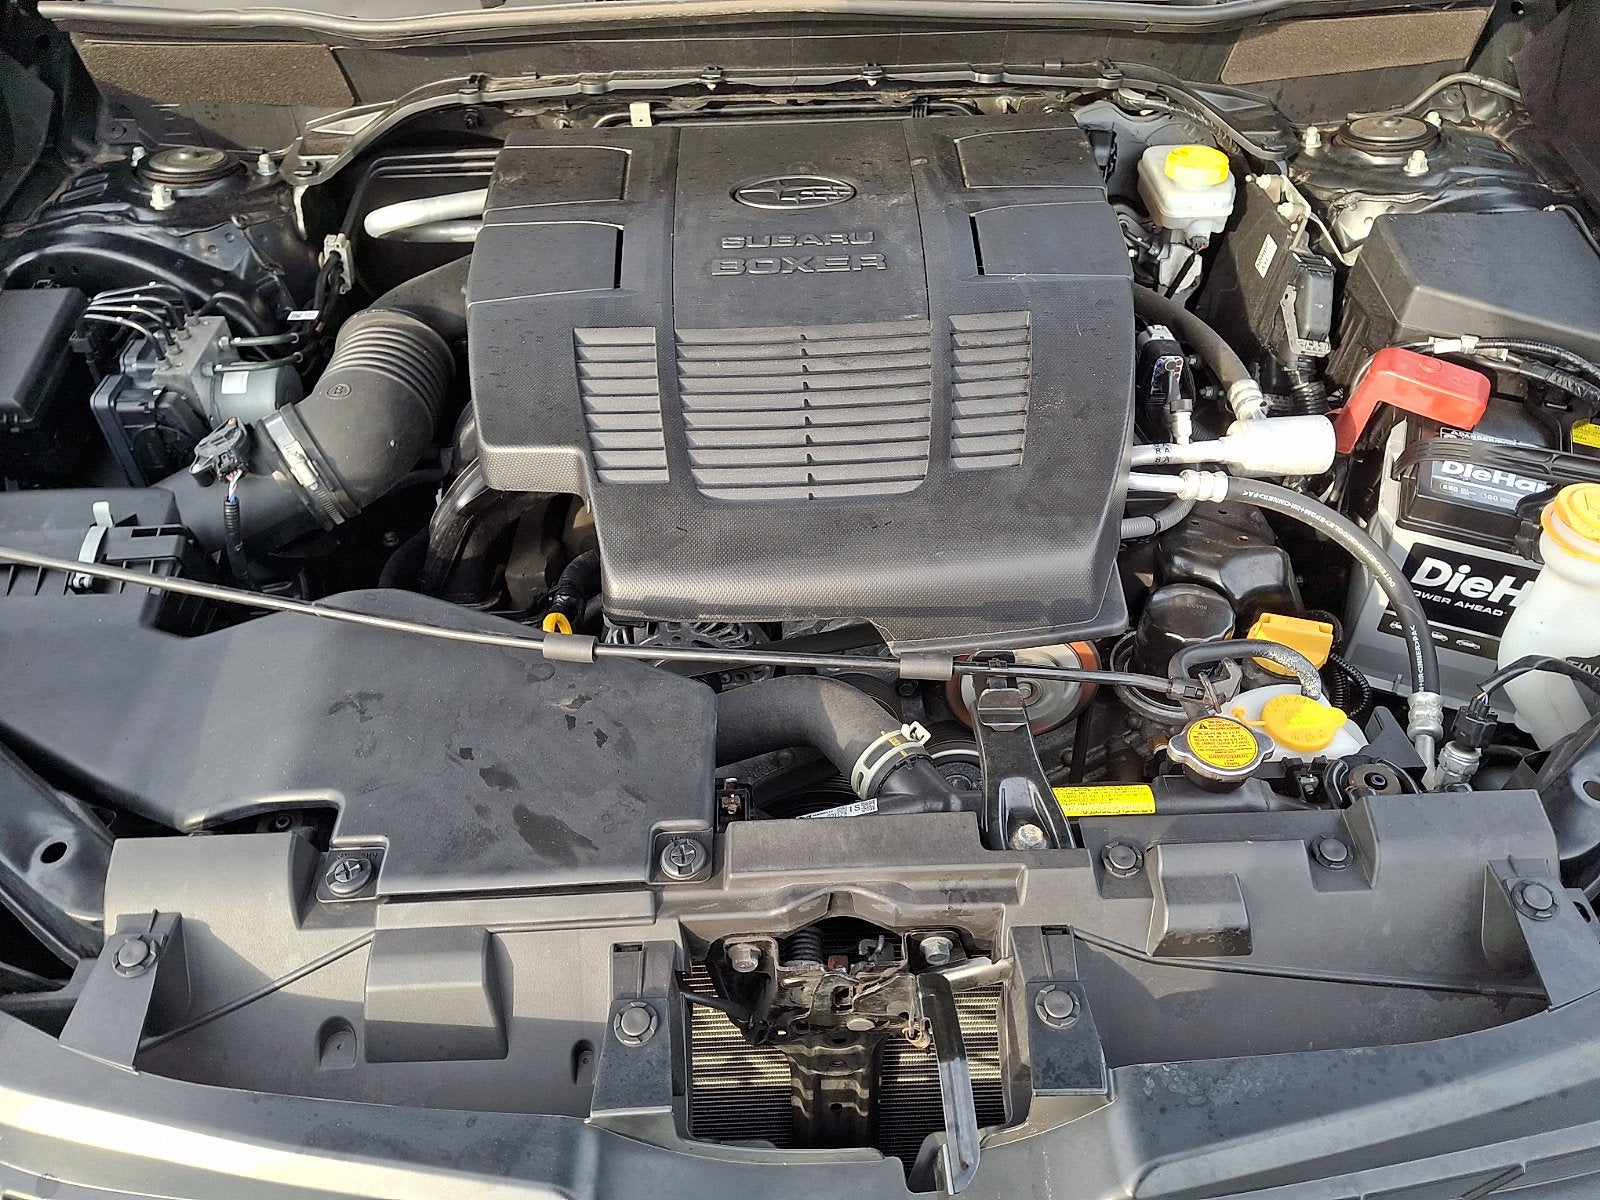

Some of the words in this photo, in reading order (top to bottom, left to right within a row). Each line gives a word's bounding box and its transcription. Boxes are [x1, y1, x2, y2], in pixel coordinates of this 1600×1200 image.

[721, 231, 875, 249] SUBARU
[711, 253, 887, 276] BOXER
[1411, 557, 1535, 608] DieH
[1412, 589, 1452, 605] OWER
[1454, 601, 1504, 617] AHEAD
